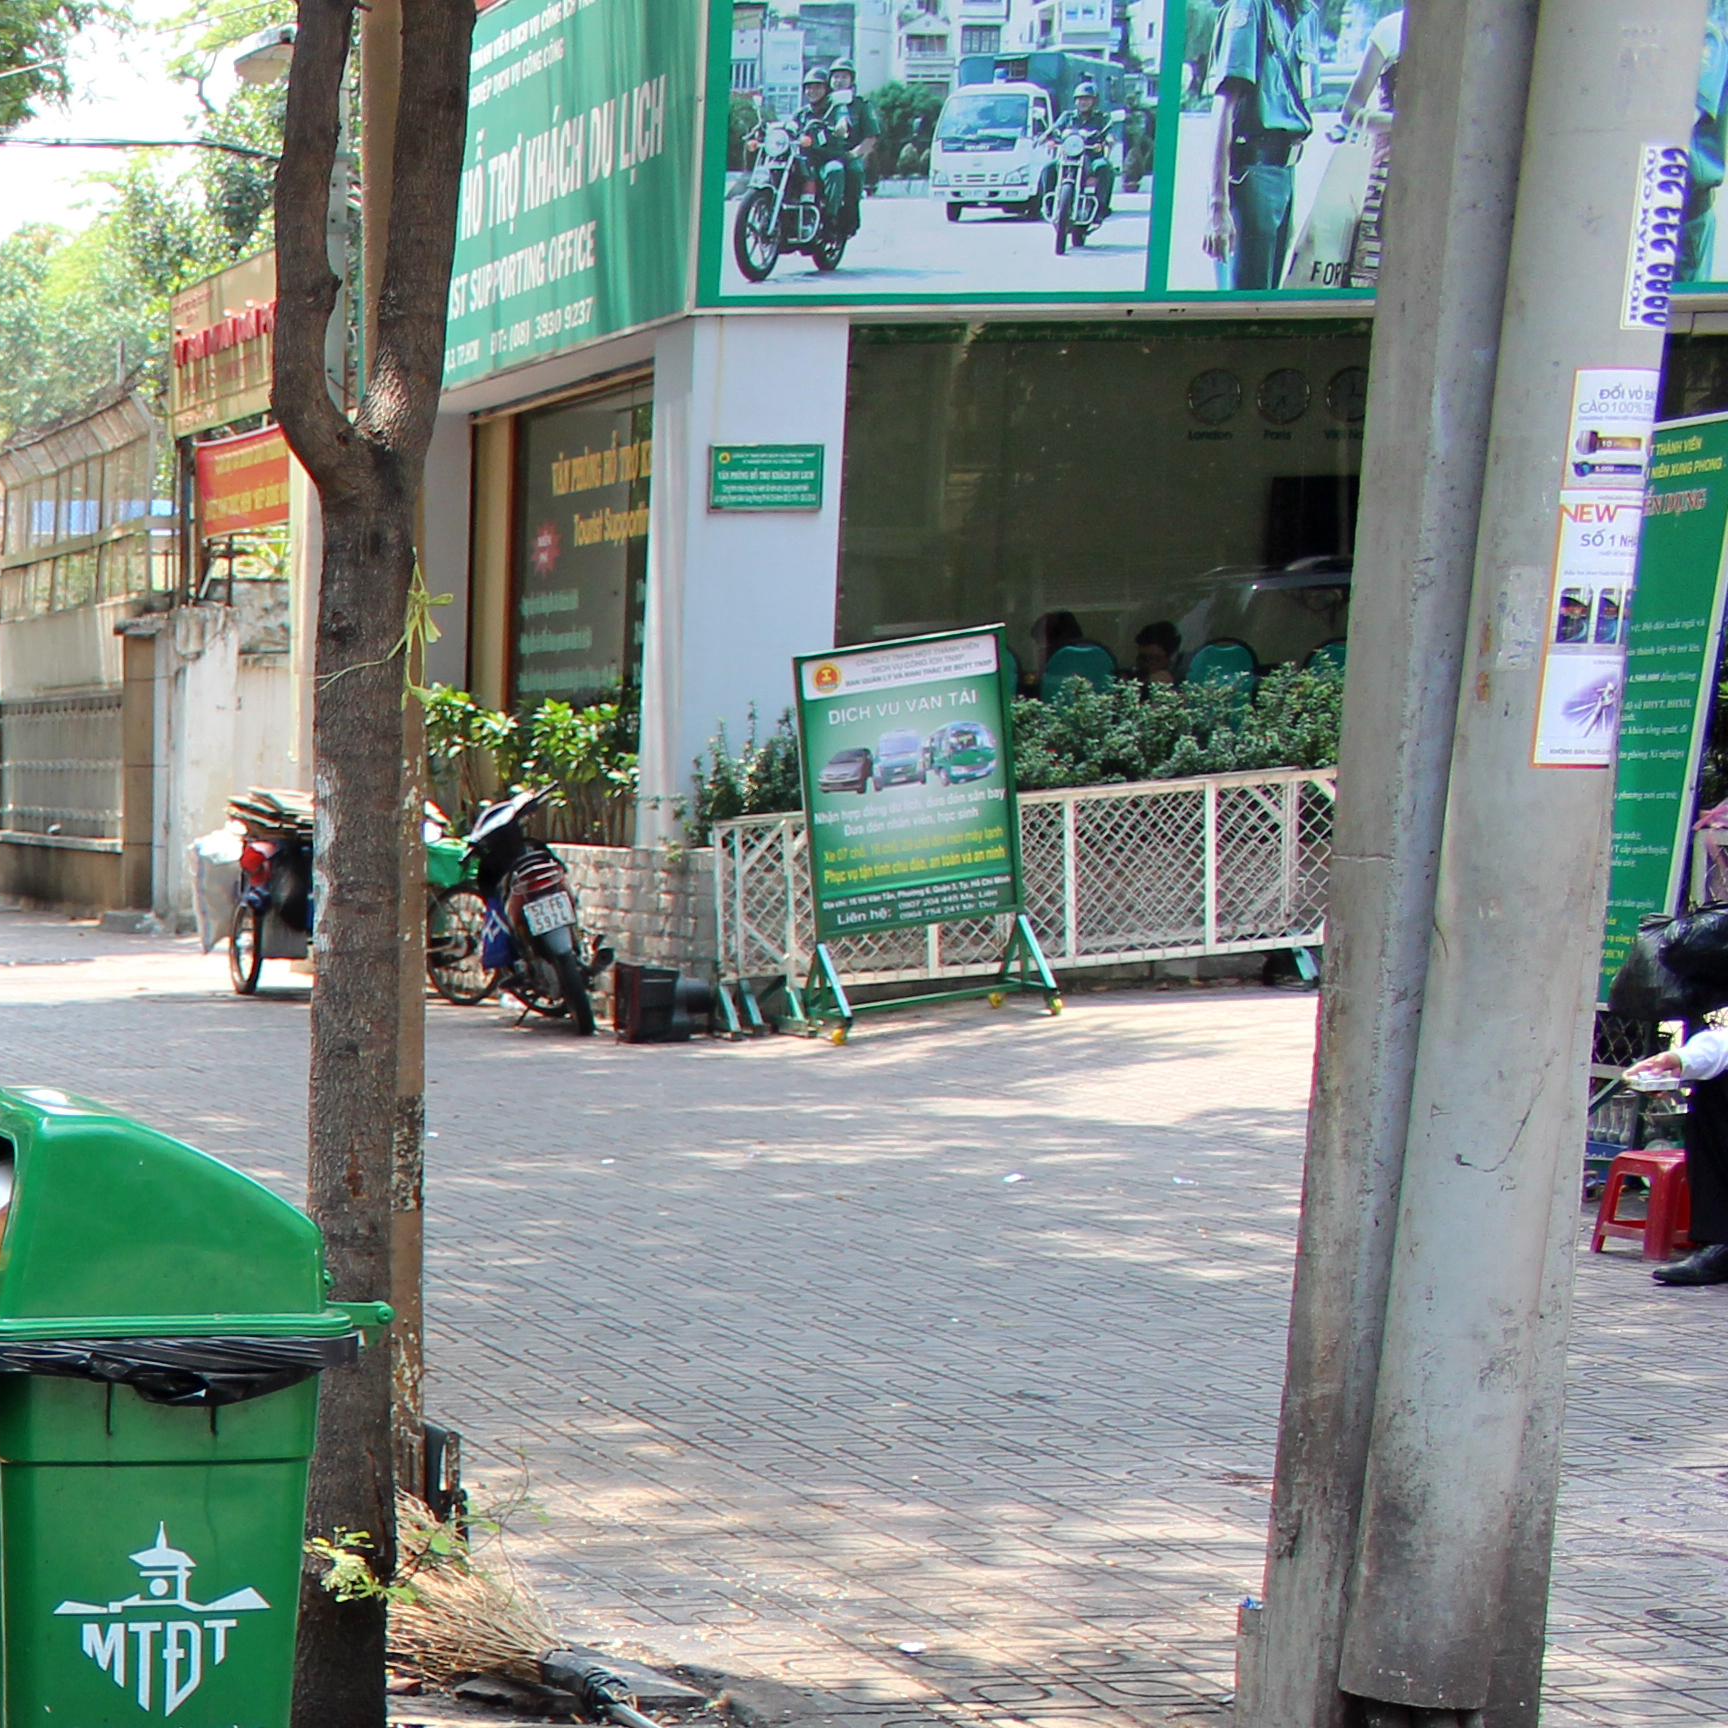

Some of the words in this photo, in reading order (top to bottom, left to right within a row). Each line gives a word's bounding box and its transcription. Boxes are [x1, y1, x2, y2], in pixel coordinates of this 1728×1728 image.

[488, 132, 523, 234] TRỢ
[524, 105, 585, 212] KHÁCH
[588, 98, 616, 184] DU
[619, 73, 667, 185] LỊCH
[470, 241, 545, 313] SUPPORTING
[548, 220, 597, 283] OFFICE
[534, 307, 562, 341] 3930
[564, 296, 595, 330] 9237
[1560, 504, 1618, 523] NEW
[828, 705, 871, 727] DỊCH
[876, 701, 900, 719] VỤ
[905, 694, 942, 714] VẬN
[948, 687, 978, 707] TẢI
[814, 810, 840, 826] Nhận
[987, 787, 1007, 802] bay
[958, 807, 979, 820] sinh
[824, 868, 847, 886] Phục
[847, 867, 859, 884] vụ
[837, 910, 867, 926] Liên
[870, 907, 892, 921] hệ:
[81, 1618, 238, 1718] MTĐT
